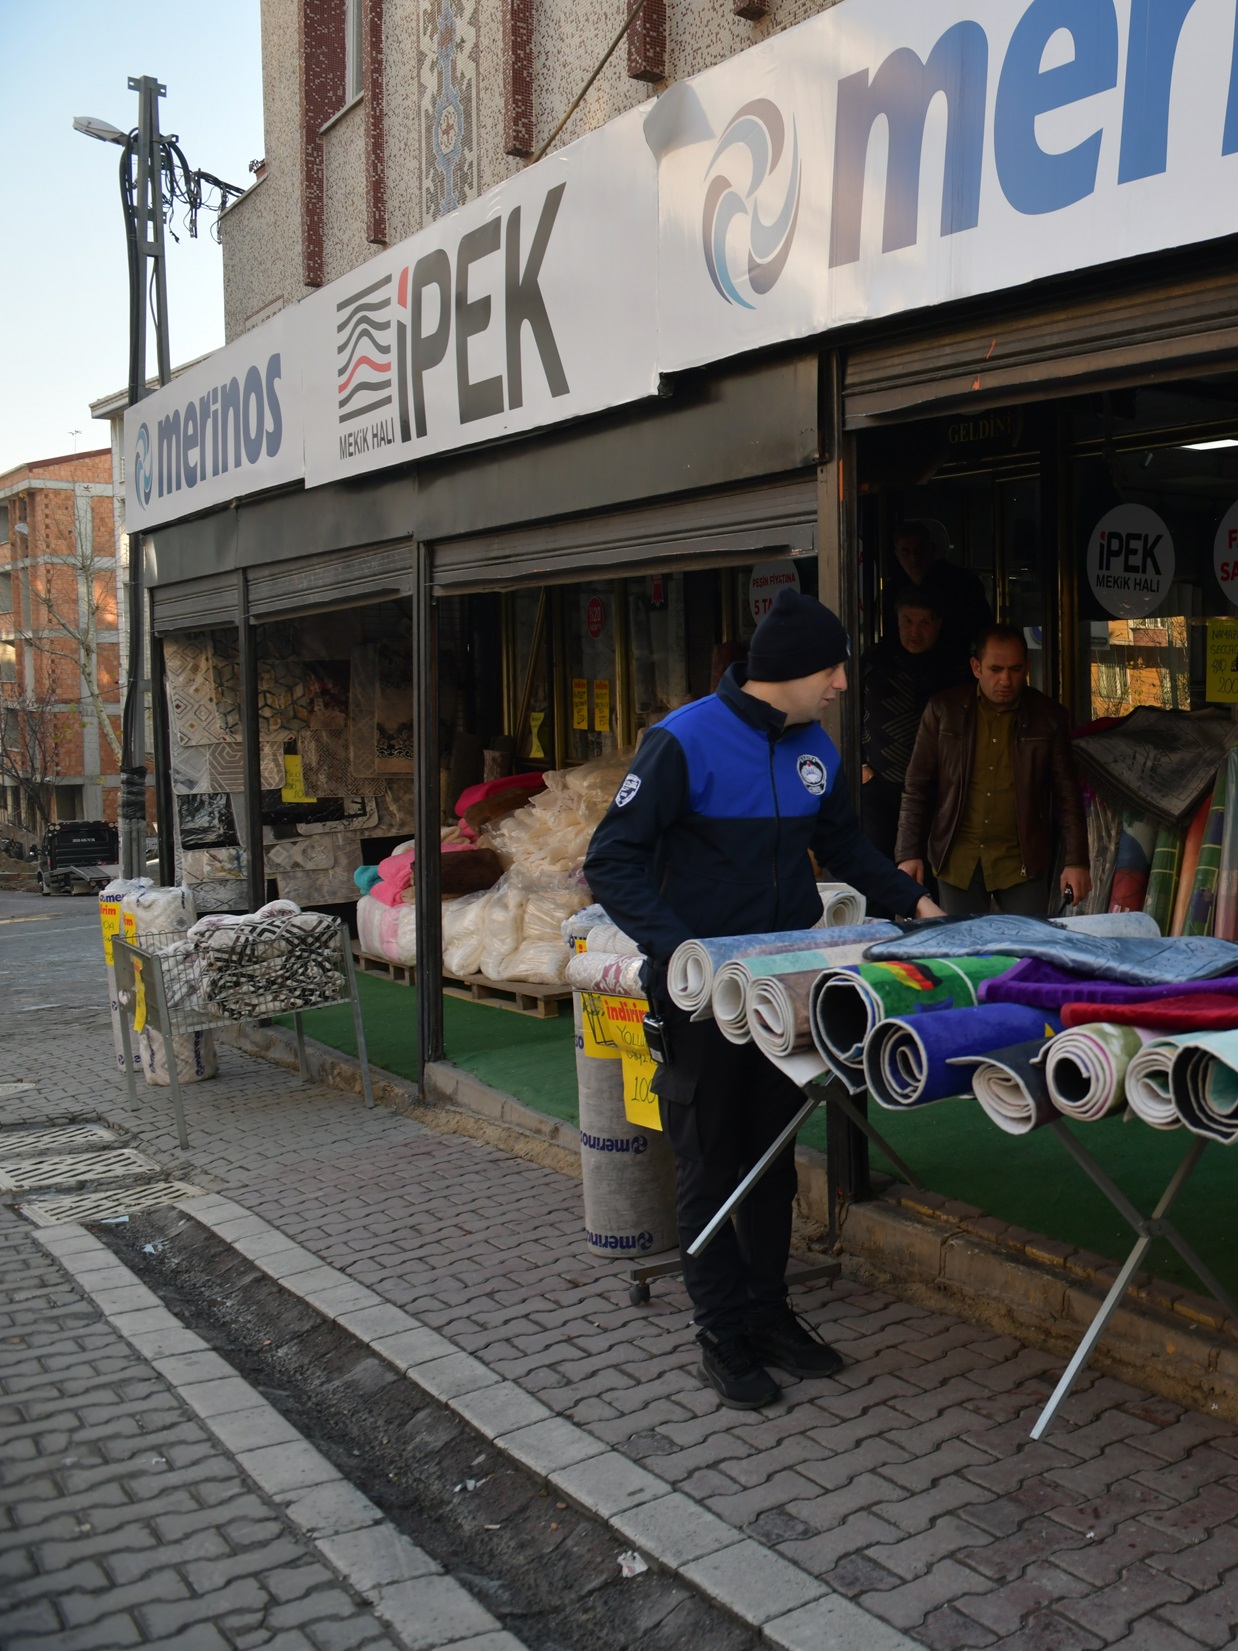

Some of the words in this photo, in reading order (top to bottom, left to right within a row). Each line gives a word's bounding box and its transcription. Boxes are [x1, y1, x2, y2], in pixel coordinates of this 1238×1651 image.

[157, 352, 283, 499] merinos
[371, 416, 395, 450] HALI
[1133, 576, 1160, 593] HALI
[754, 600, 760, 615] 5
[581, 1130, 630, 1153] merino
